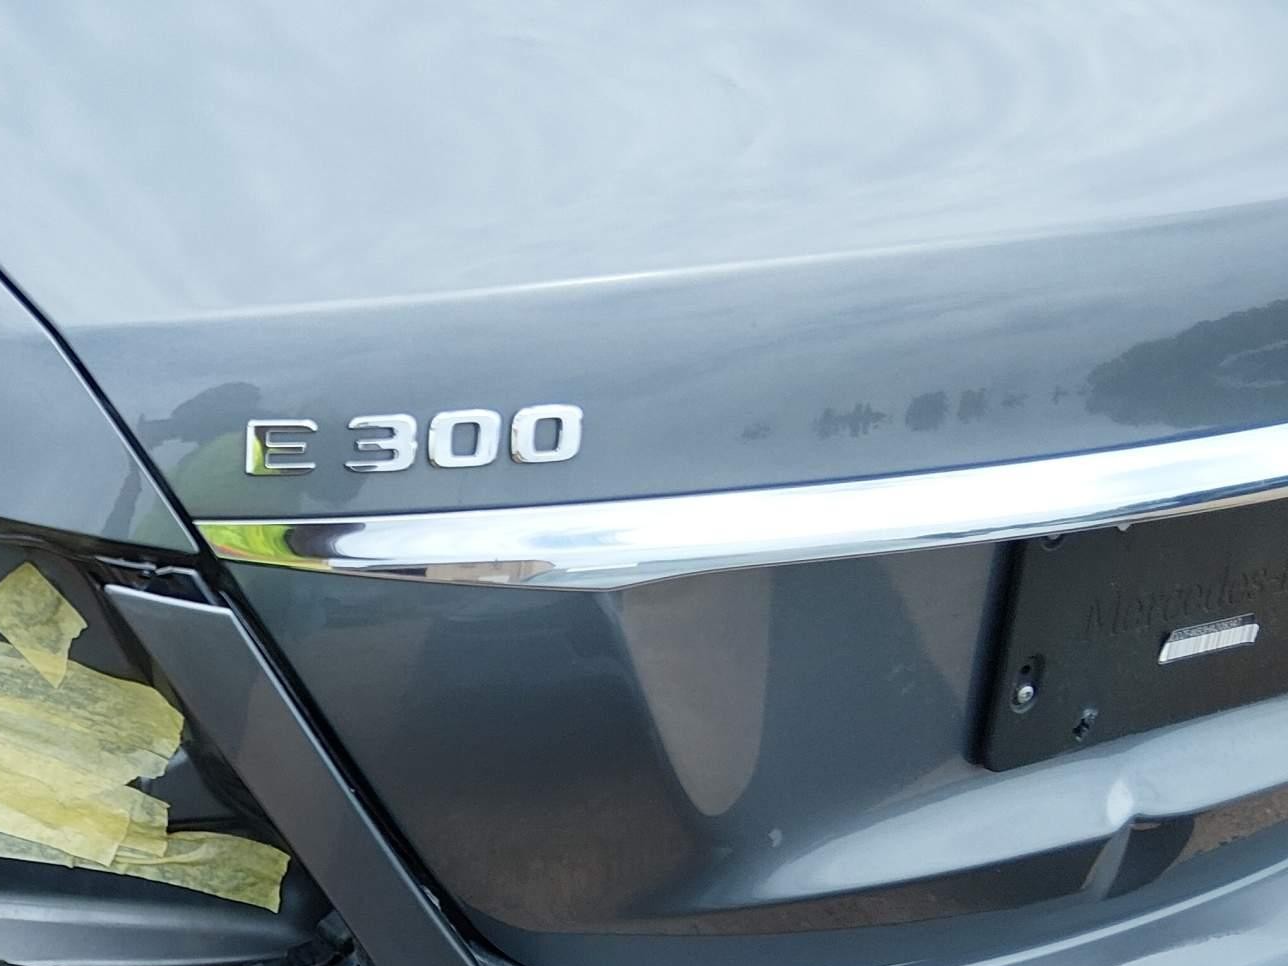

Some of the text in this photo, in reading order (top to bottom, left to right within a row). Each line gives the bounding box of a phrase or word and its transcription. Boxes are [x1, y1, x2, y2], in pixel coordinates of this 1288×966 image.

[245, 404, 584, 477] E 300
[1083, 559, 1288, 635] Mercedes-
